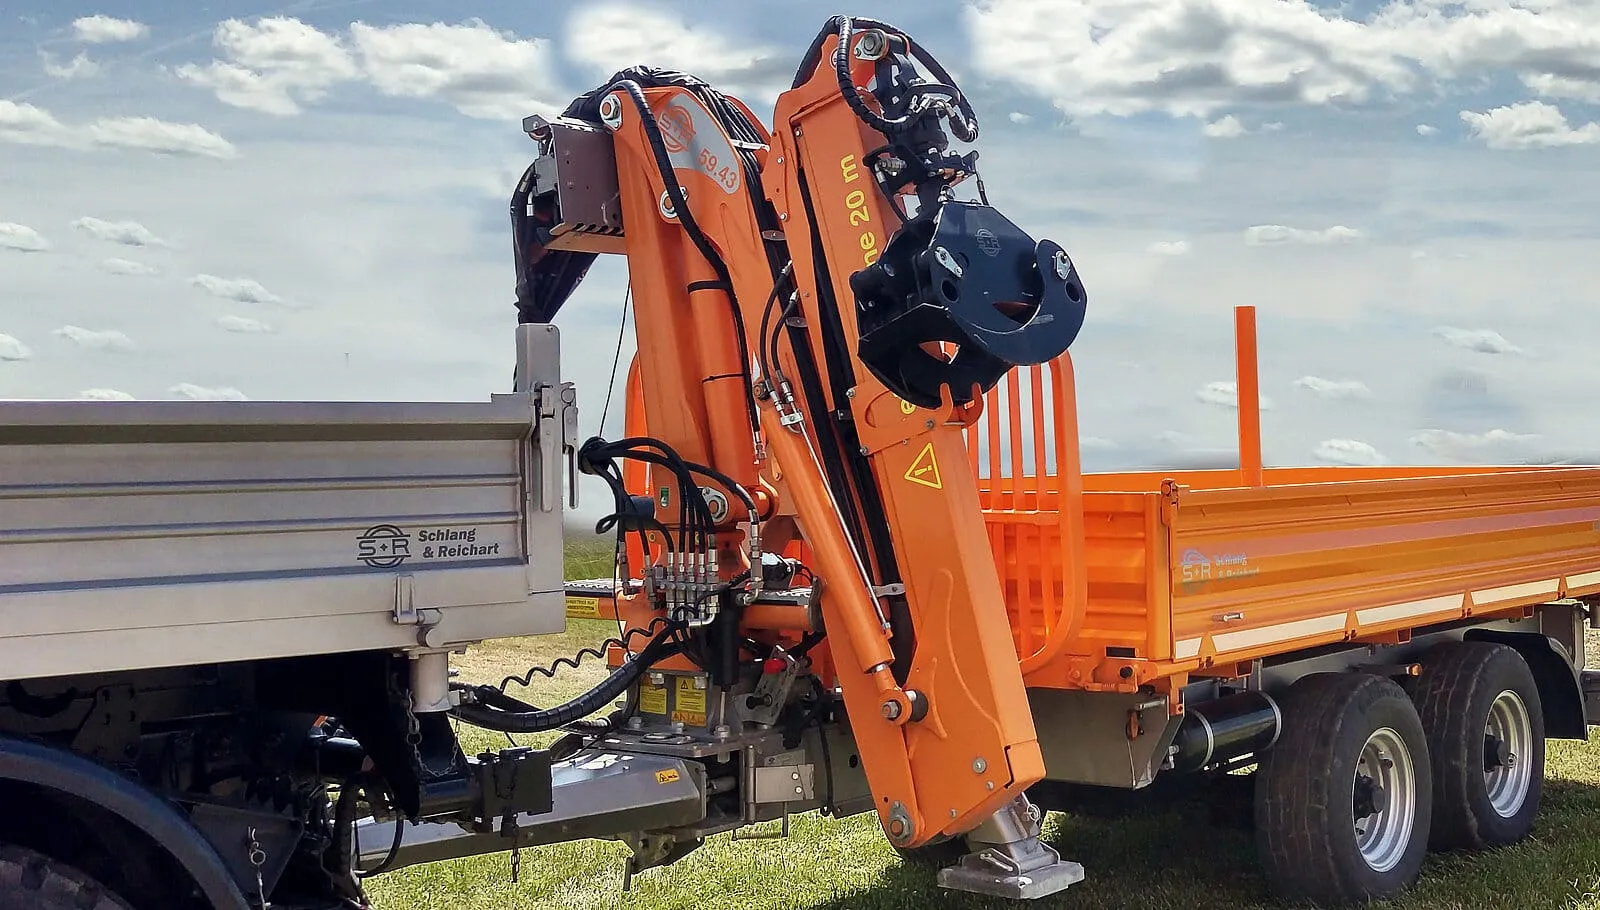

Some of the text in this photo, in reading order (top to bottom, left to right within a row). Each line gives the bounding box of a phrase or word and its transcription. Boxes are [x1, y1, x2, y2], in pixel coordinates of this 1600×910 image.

[697, 147, 737, 189] 59.43
[840, 154, 859, 183] m
[845, 190, 870, 227] 20
[418, 528, 476, 542] Schlang
[423, 543, 499, 558] & Reichart
